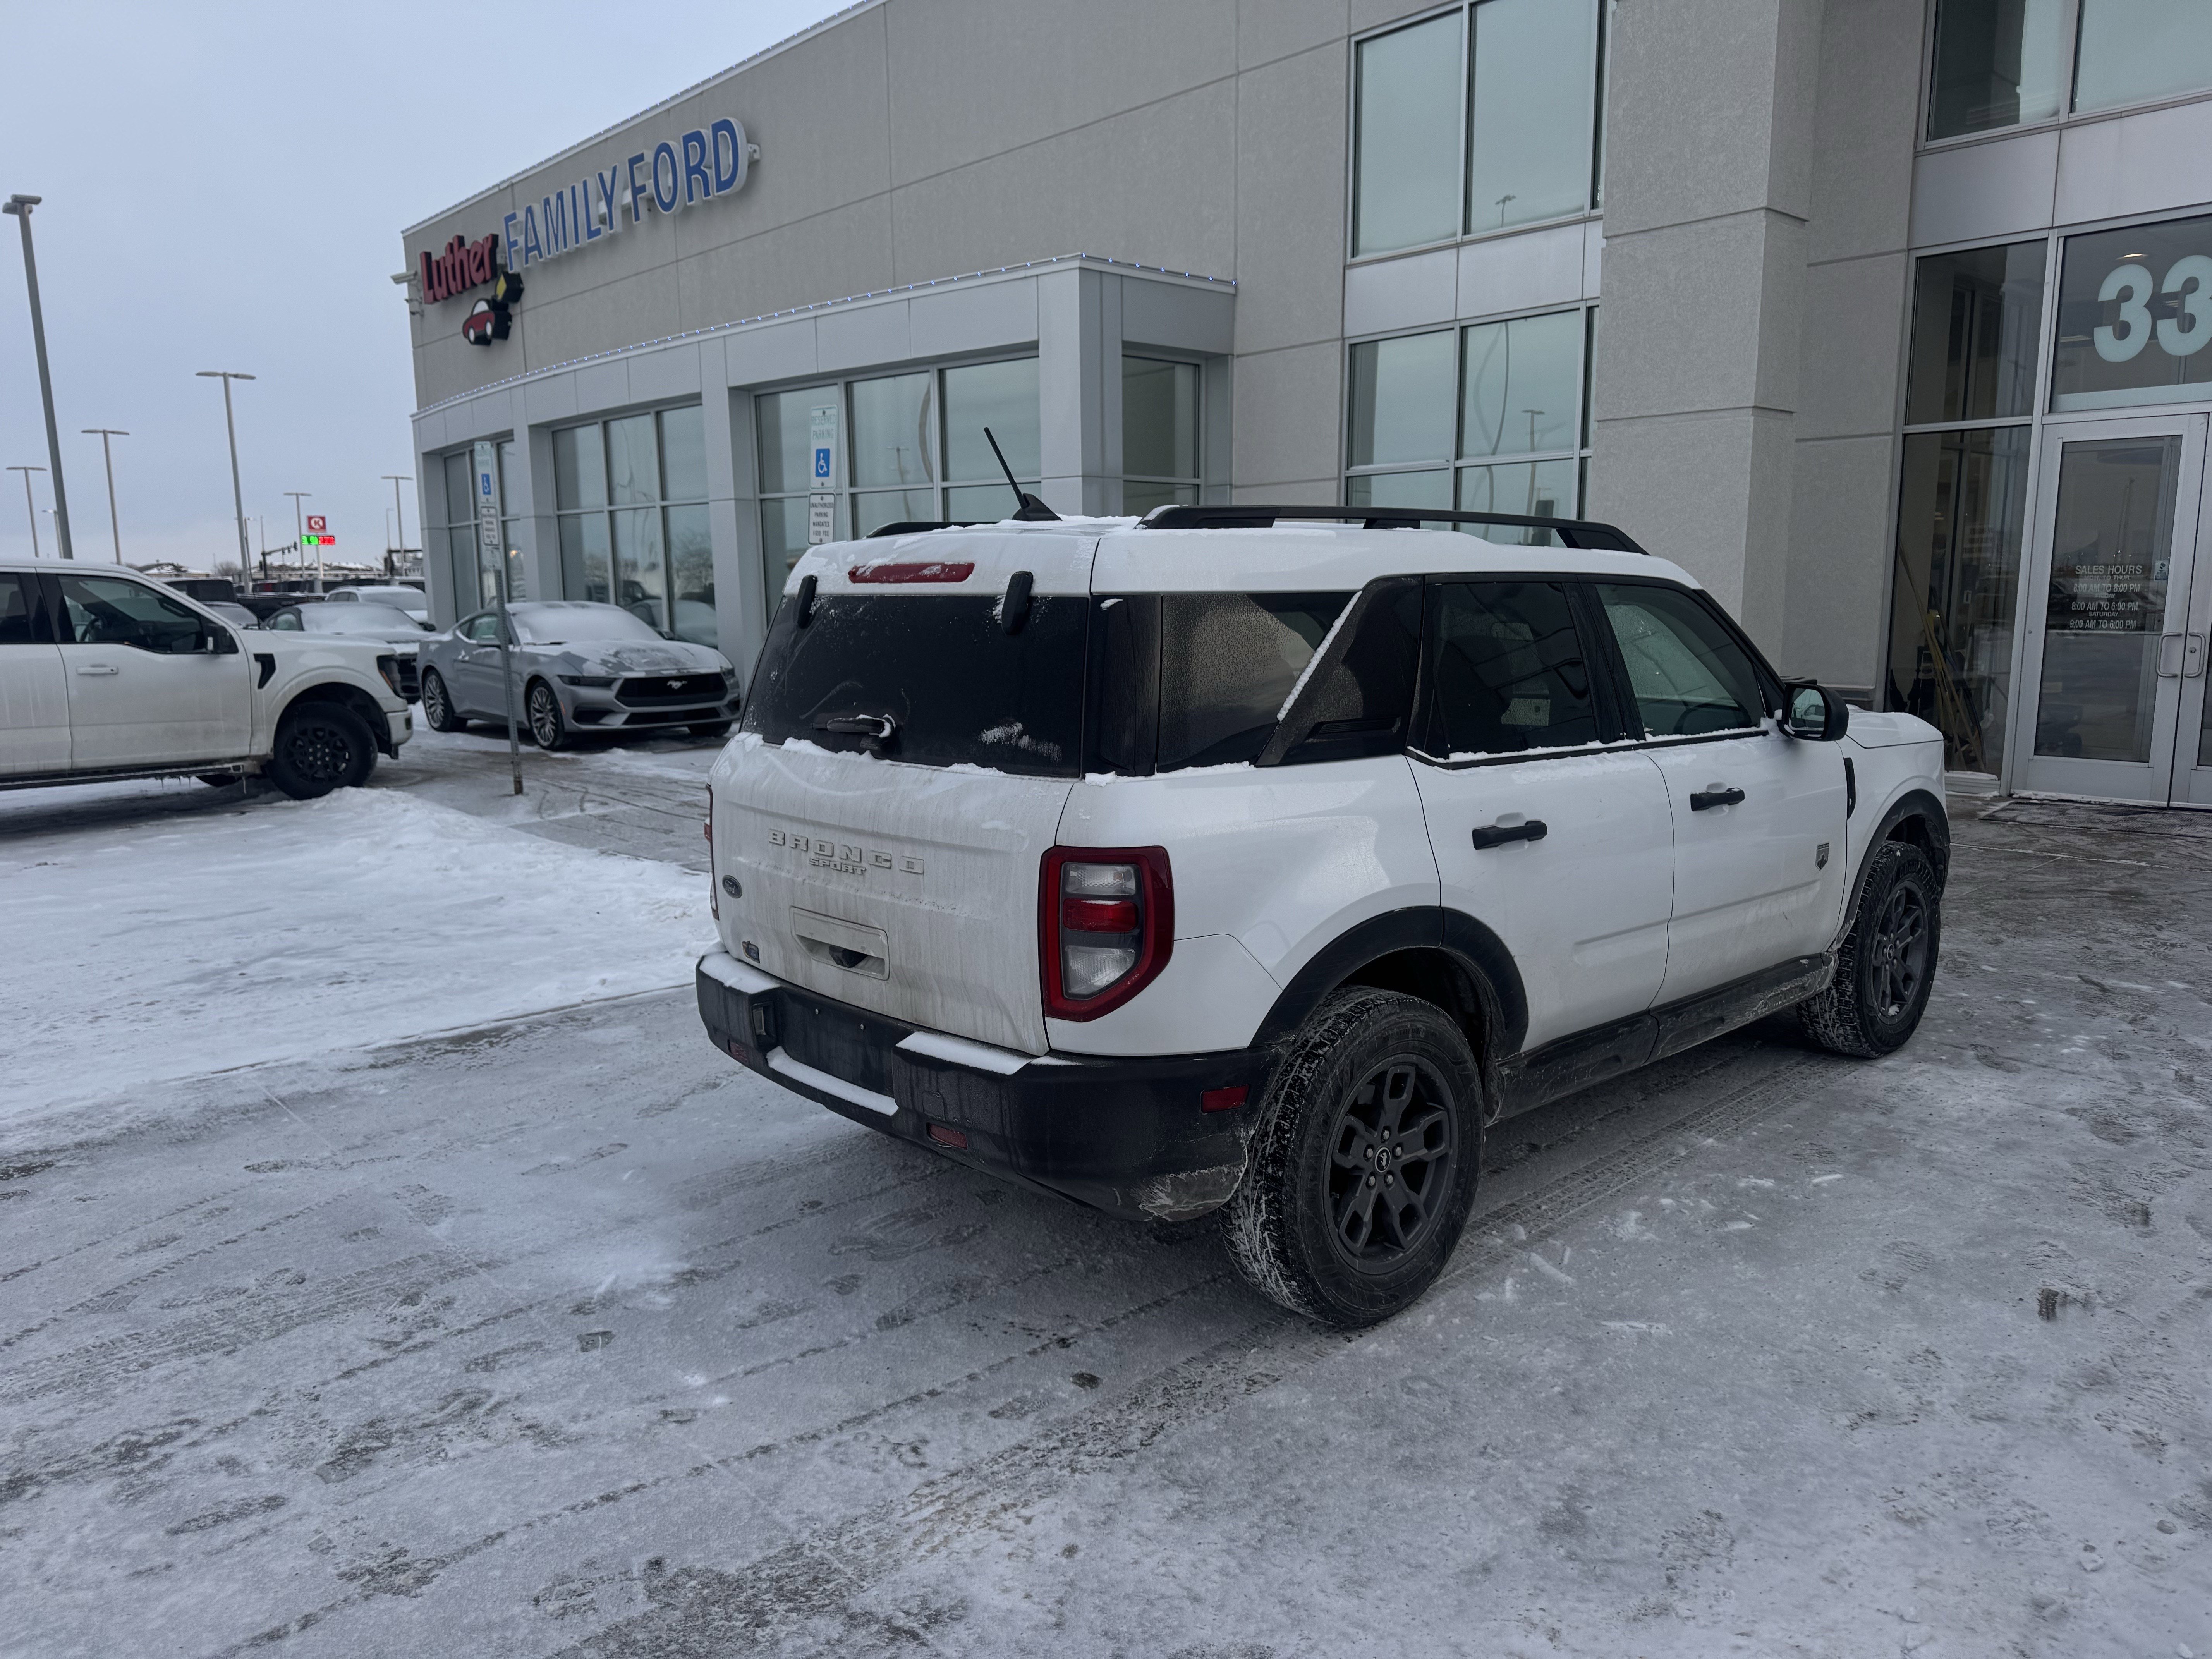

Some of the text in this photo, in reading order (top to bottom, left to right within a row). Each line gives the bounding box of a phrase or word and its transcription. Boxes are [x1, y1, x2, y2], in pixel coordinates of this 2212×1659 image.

[420, 117, 744, 304] Luther FAMILY FORD
[812, 429, 834, 440] PARKING
[2075, 565, 2142, 574] SALES HOURS
[2073, 583, 2140, 592] 8:00 AM TO 8:00 PM
[2071, 601, 2138, 611] 8:00 AM TO 6:00 PM
[2069, 619, 2137, 629] 9:00 AM TO 6:00 PM
[768, 828, 925, 874] BRONCO
[809, 857, 867, 875] SPORT
